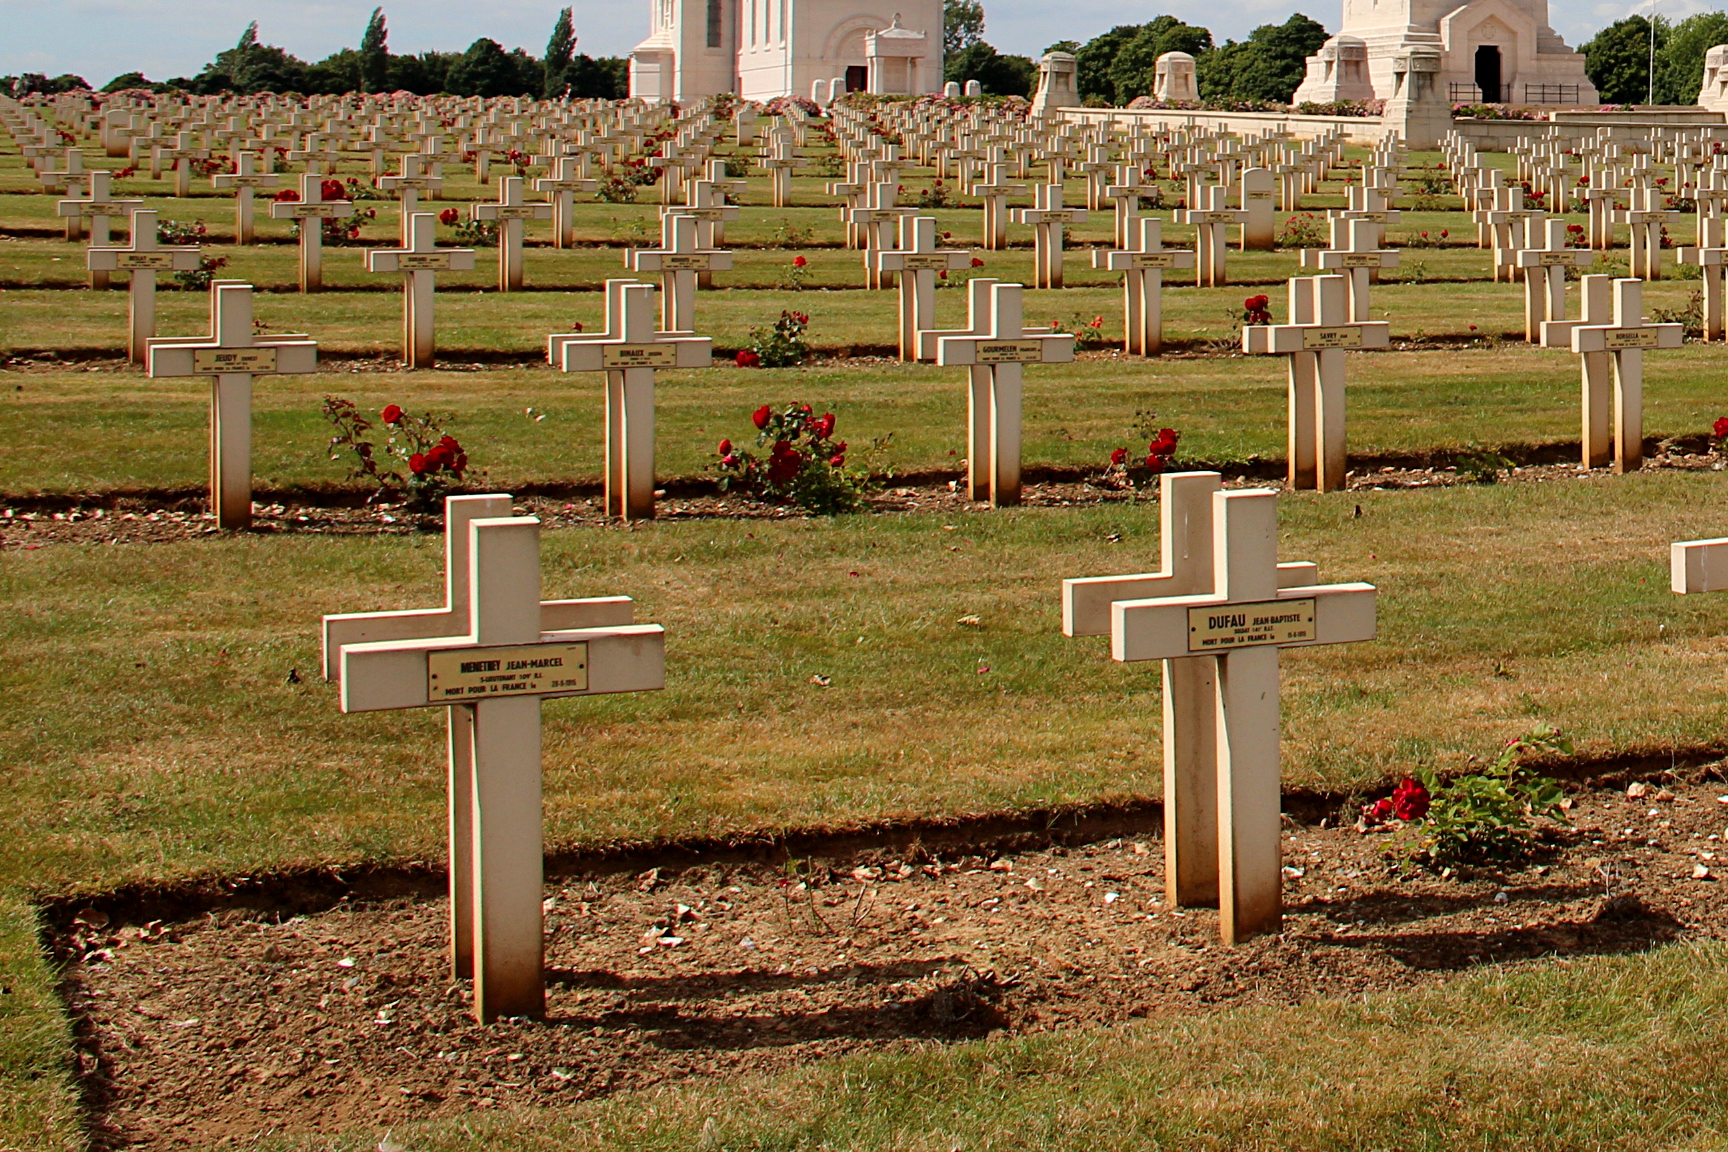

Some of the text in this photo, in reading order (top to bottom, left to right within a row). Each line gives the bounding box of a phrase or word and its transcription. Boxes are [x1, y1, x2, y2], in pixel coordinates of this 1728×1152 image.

[1209, 614, 1300, 629] DUFAU JEAN-BAPTISTE
[506, 658, 563, 670] JEAN-MARCEL
[446, 687, 464, 695] MORT
[491, 684, 498, 692] LA
[503, 683, 526, 691] FRANCE
